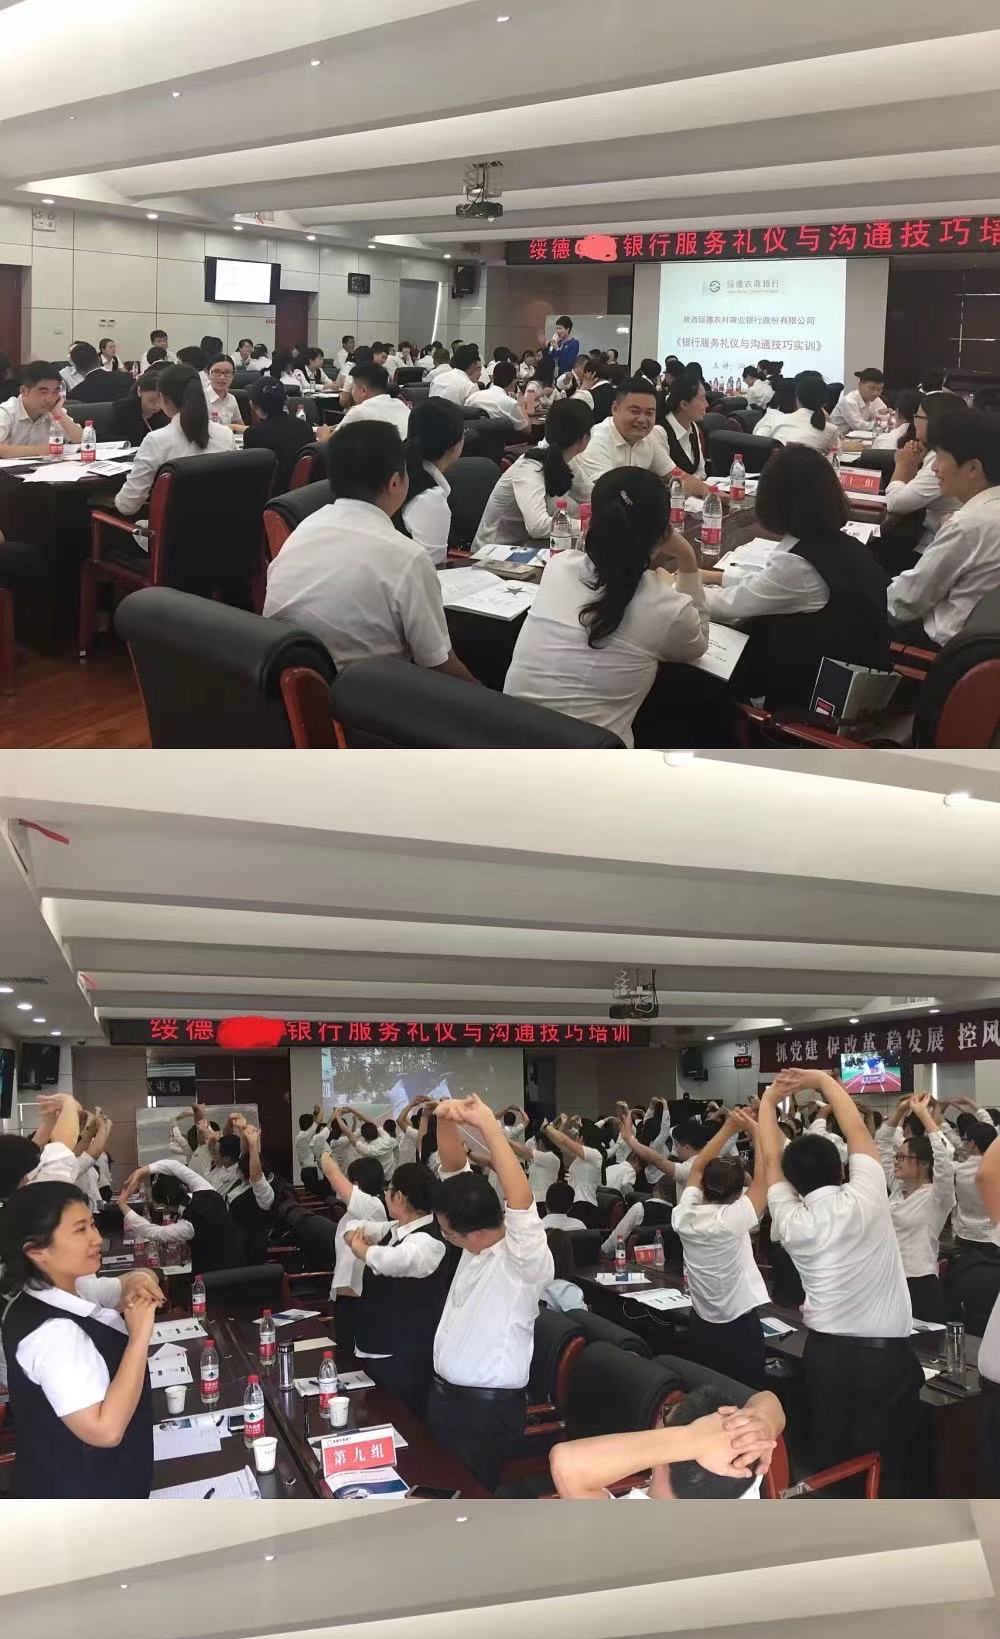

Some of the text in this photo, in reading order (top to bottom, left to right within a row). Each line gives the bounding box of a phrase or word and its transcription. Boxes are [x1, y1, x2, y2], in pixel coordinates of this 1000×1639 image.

[529, 216, 1000, 260] 绥德银行服务礼仪与沟通技巧培
[150, 1017, 630, 1043] 绥德银行服务礼仪与沟通技巧培训
[776, 1038, 818, 1062] 抓党建
[886, 1025, 944, 1054] 稳发展
